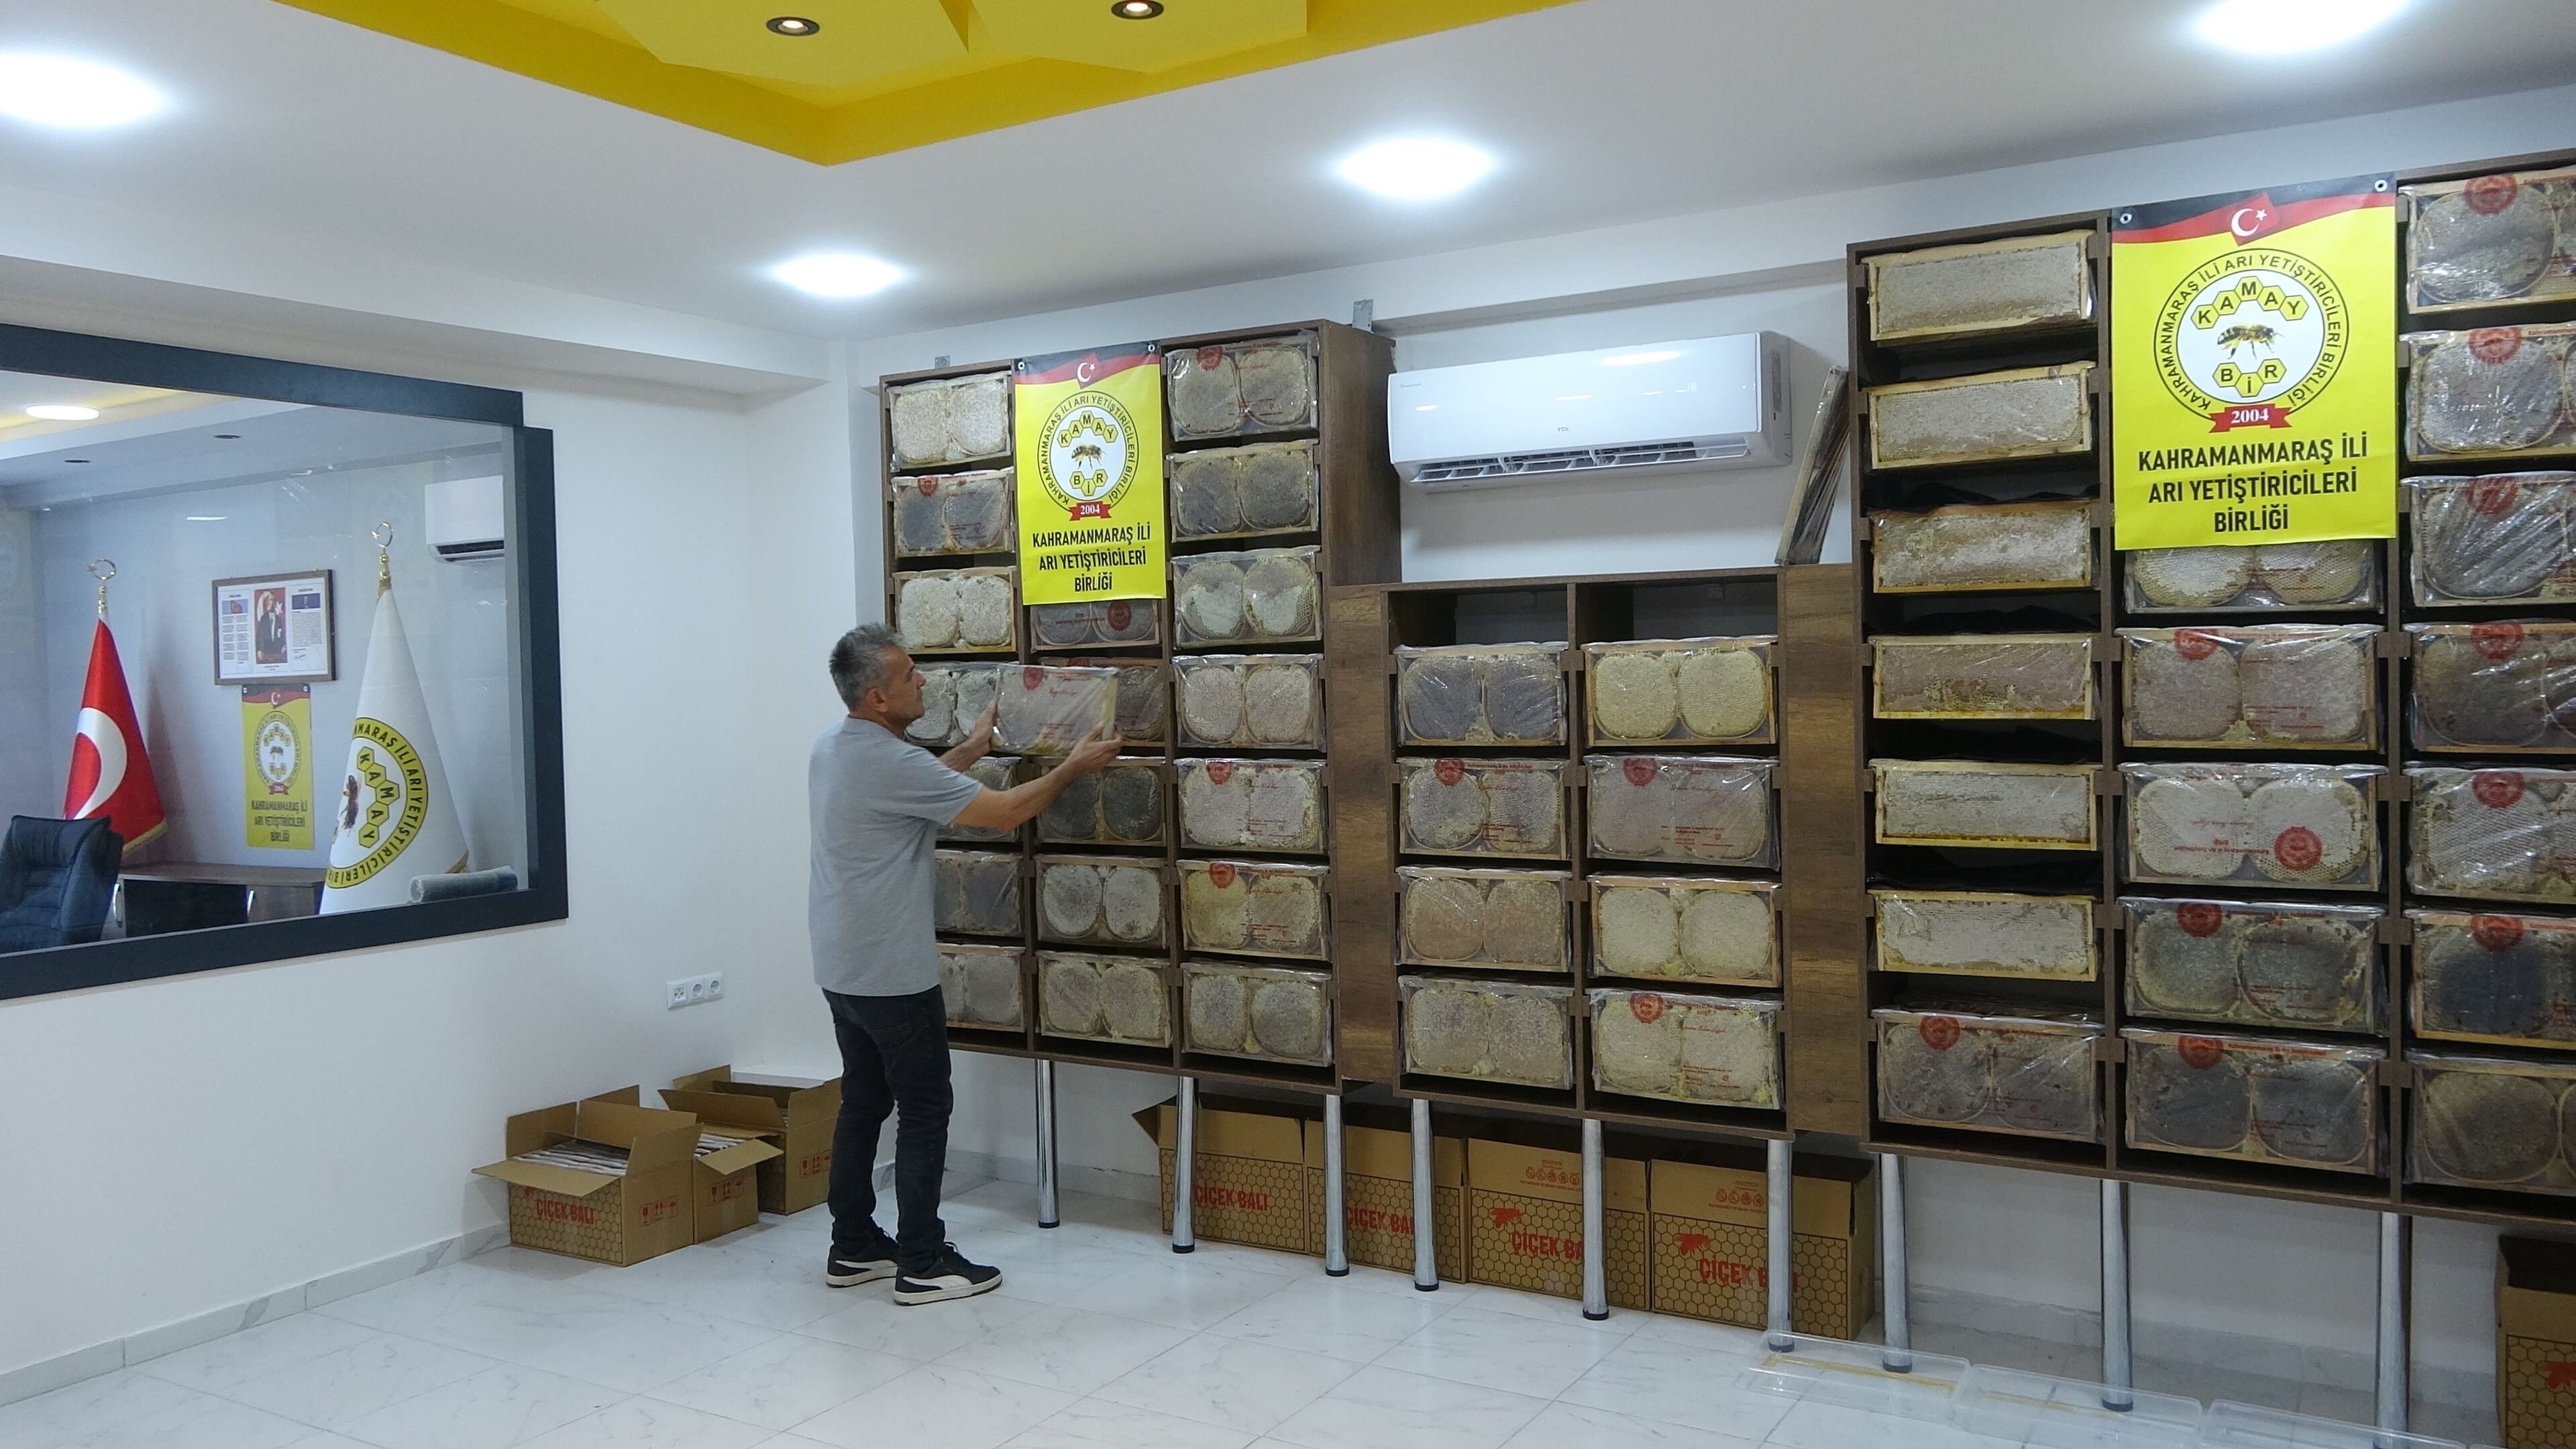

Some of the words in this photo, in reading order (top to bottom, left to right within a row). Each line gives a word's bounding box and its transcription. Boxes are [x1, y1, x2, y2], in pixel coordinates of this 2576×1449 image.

[2198, 262, 2220, 282] İLİ
[2225, 256, 2252, 271] ARI
[2259, 255, 2341, 348] YETİŞTİRİCİLERİ
[2161, 281, 2211, 410] KAHRAMANMARAŞ
[2288, 352, 2335, 407] BİRLİĞİ
[1074, 395, 1089, 407] ARI
[2231, 408, 2269, 424] 2004
[2139, 438, 2333, 472] KAHRAMANMARAŞ
[2342, 431, 2367, 458] İLİ
[2148, 481, 2183, 504] ARI
[2190, 466, 2357, 504] YETİŞTİRİCİLERİ
[1080, 504, 1100, 515] 2004
[2214, 500, 2289, 533] BİRLİĞİ
[1032, 526, 1134, 548] KAHRAMANMARAŞ
[1137, 521, 1150, 541] İLİ
[1039, 555, 1058, 571] ARI
[1059, 545, 1146, 572] YETİŞTİRİCİLERİ
[1074, 571, 1112, 593] BİRLİĞİ
[1195, 1183, 1235, 1208] ÇİÇEK
[1238, 1191, 1267, 1211] BALI
[1511, 1228, 1560, 1258] ÇİÇEK
[1564, 1238, 1583, 1260] BA
[1699, 1254, 1753, 1287] ÇİÇEK
